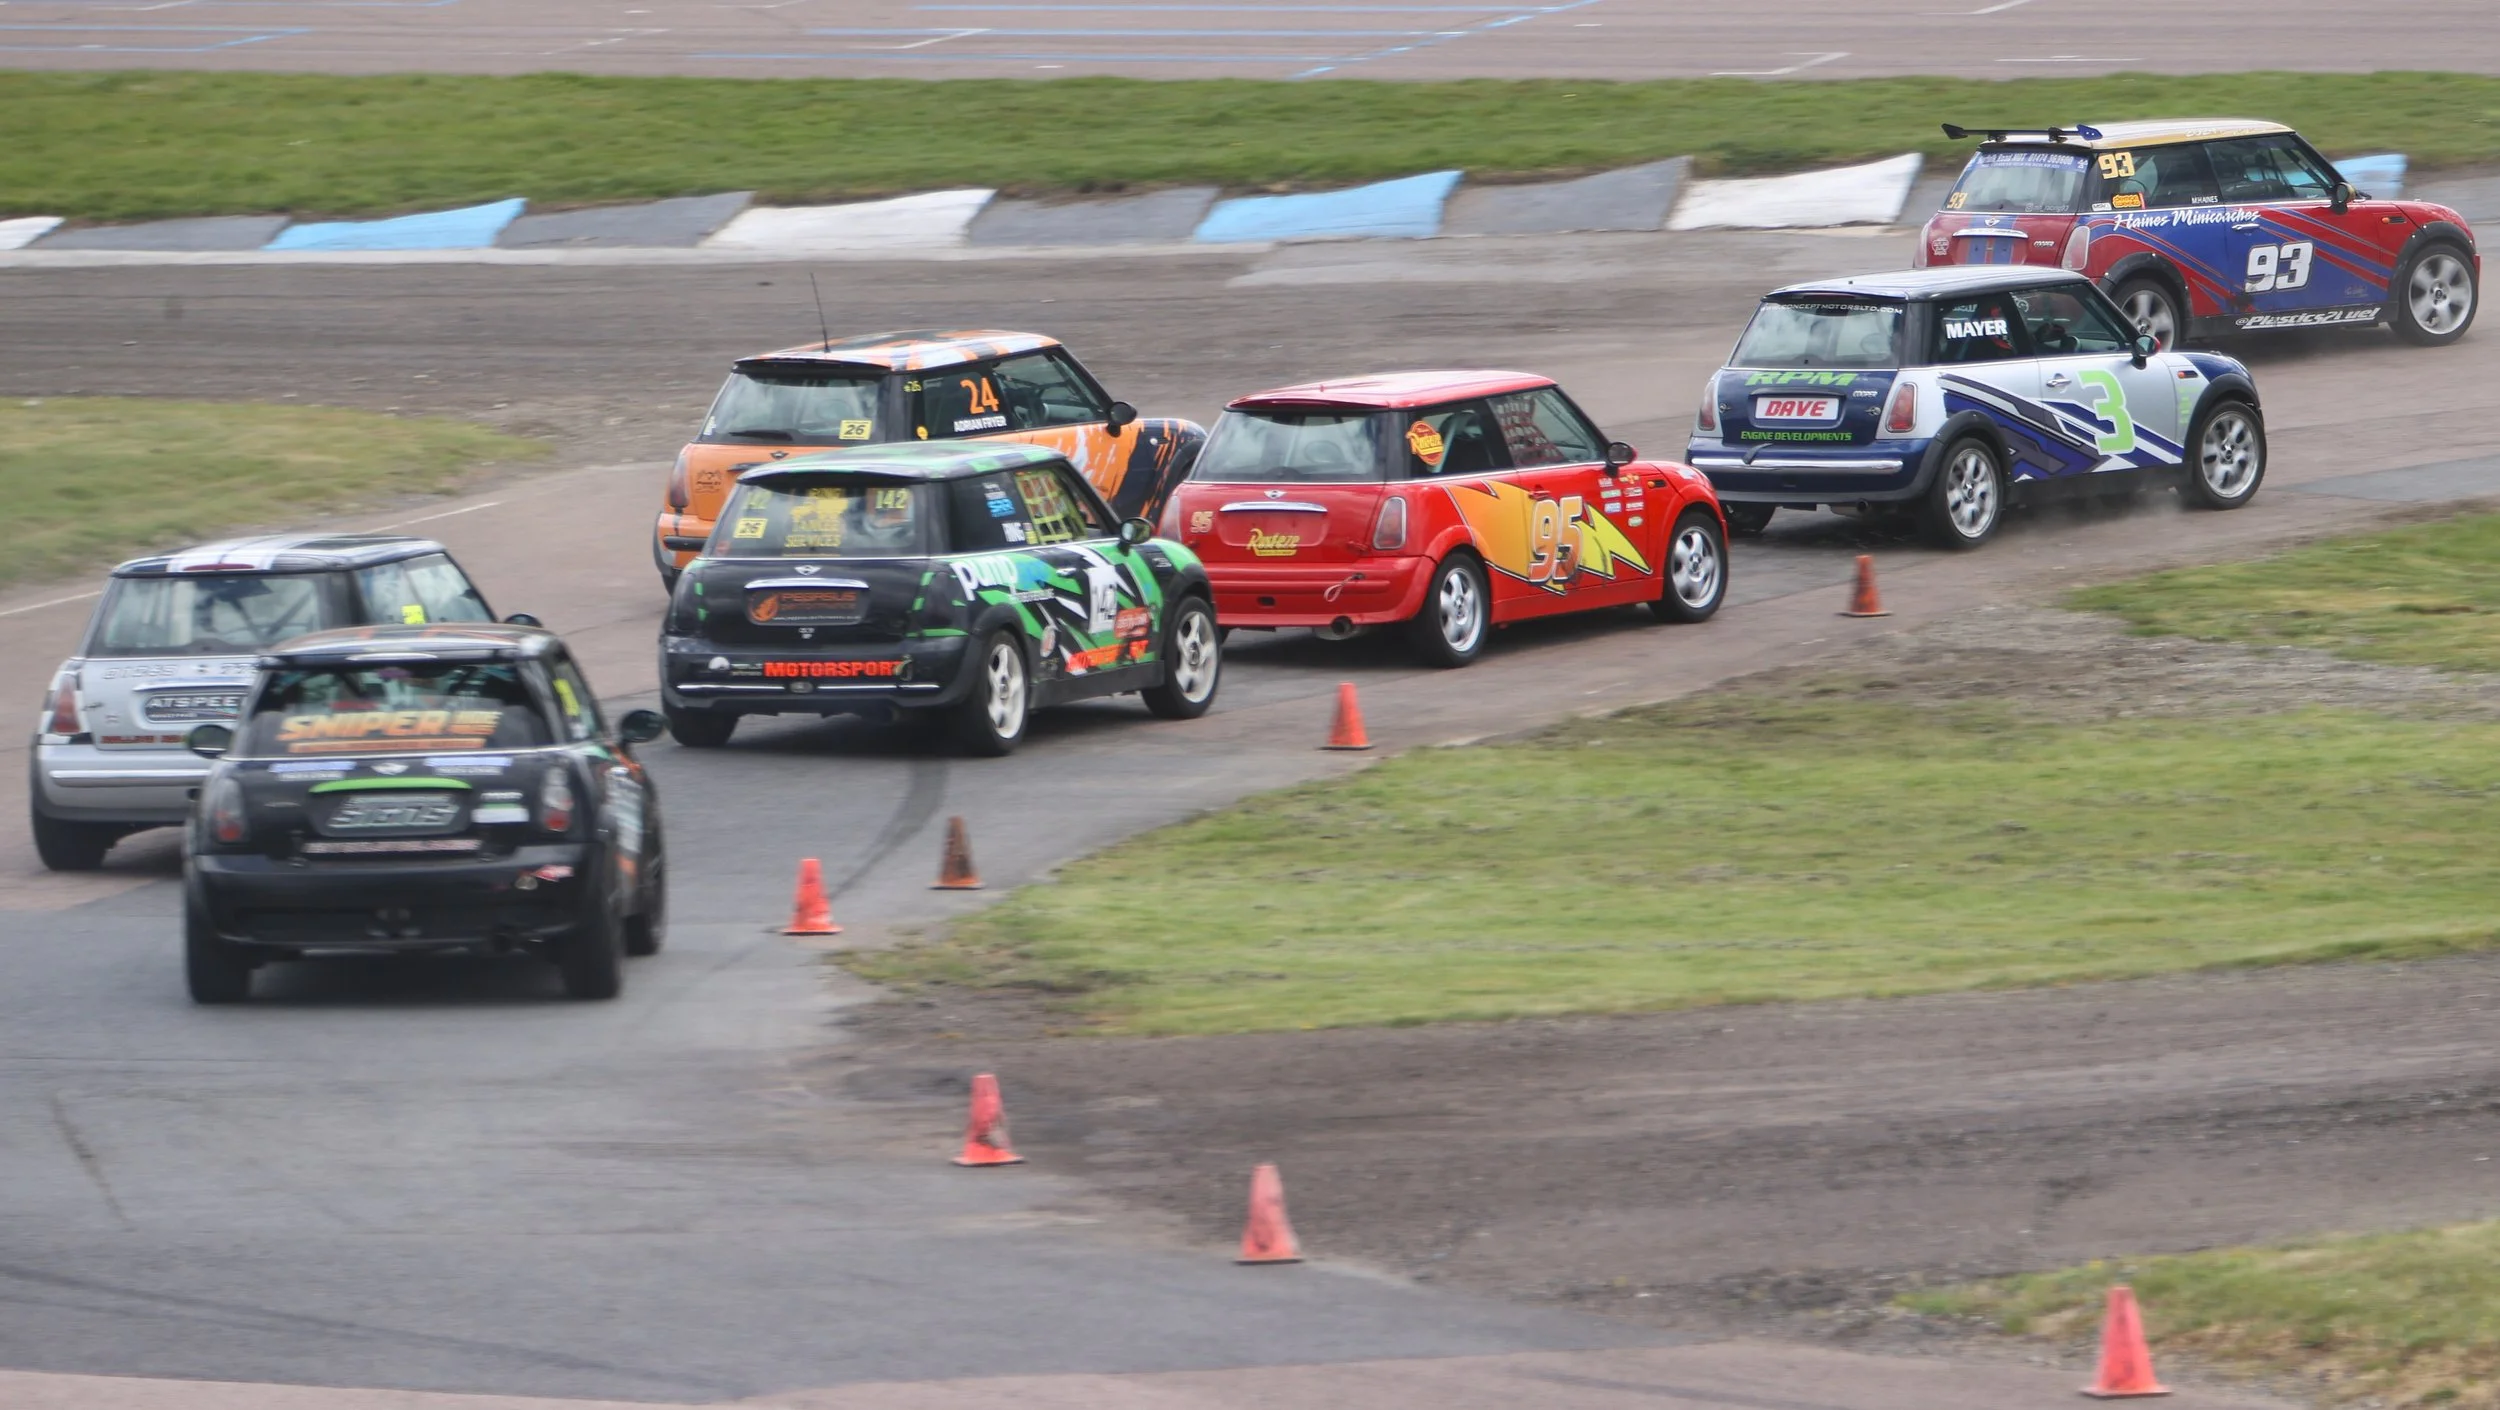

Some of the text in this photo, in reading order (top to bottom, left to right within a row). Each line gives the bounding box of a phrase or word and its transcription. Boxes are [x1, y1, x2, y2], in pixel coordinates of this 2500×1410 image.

[2098, 152, 2135, 179] 93
[1947, 192, 1968, 208] 93
[2113, 208, 2261, 231] Haines Minicoaches
[2244, 241, 2314, 293] 93
[1945, 319, 2008, 339] MAYER
[1744, 371, 1858, 386] RPM
[960, 377, 999, 414] 24
[1765, 400, 1828, 417] DAVE
[2077, 369, 2137, 456] 3
[845, 425, 865, 436] 26
[953, 415, 1008, 432] ADRIAN FRYER
[1741, 431, 1852, 441] ENGINE DEVELOPMENTS
[875, 489, 911, 509] 142
[739, 522, 760, 533] 26
[1190, 511, 1213, 533] 95
[784, 534, 841, 548] SERVICES
[1528, 495, 1583, 584] 95
[764, 661, 904, 677] MOTORSPORT
[149, 697, 242, 708] ATSPEE
[275, 711, 452, 742] SNIPER
